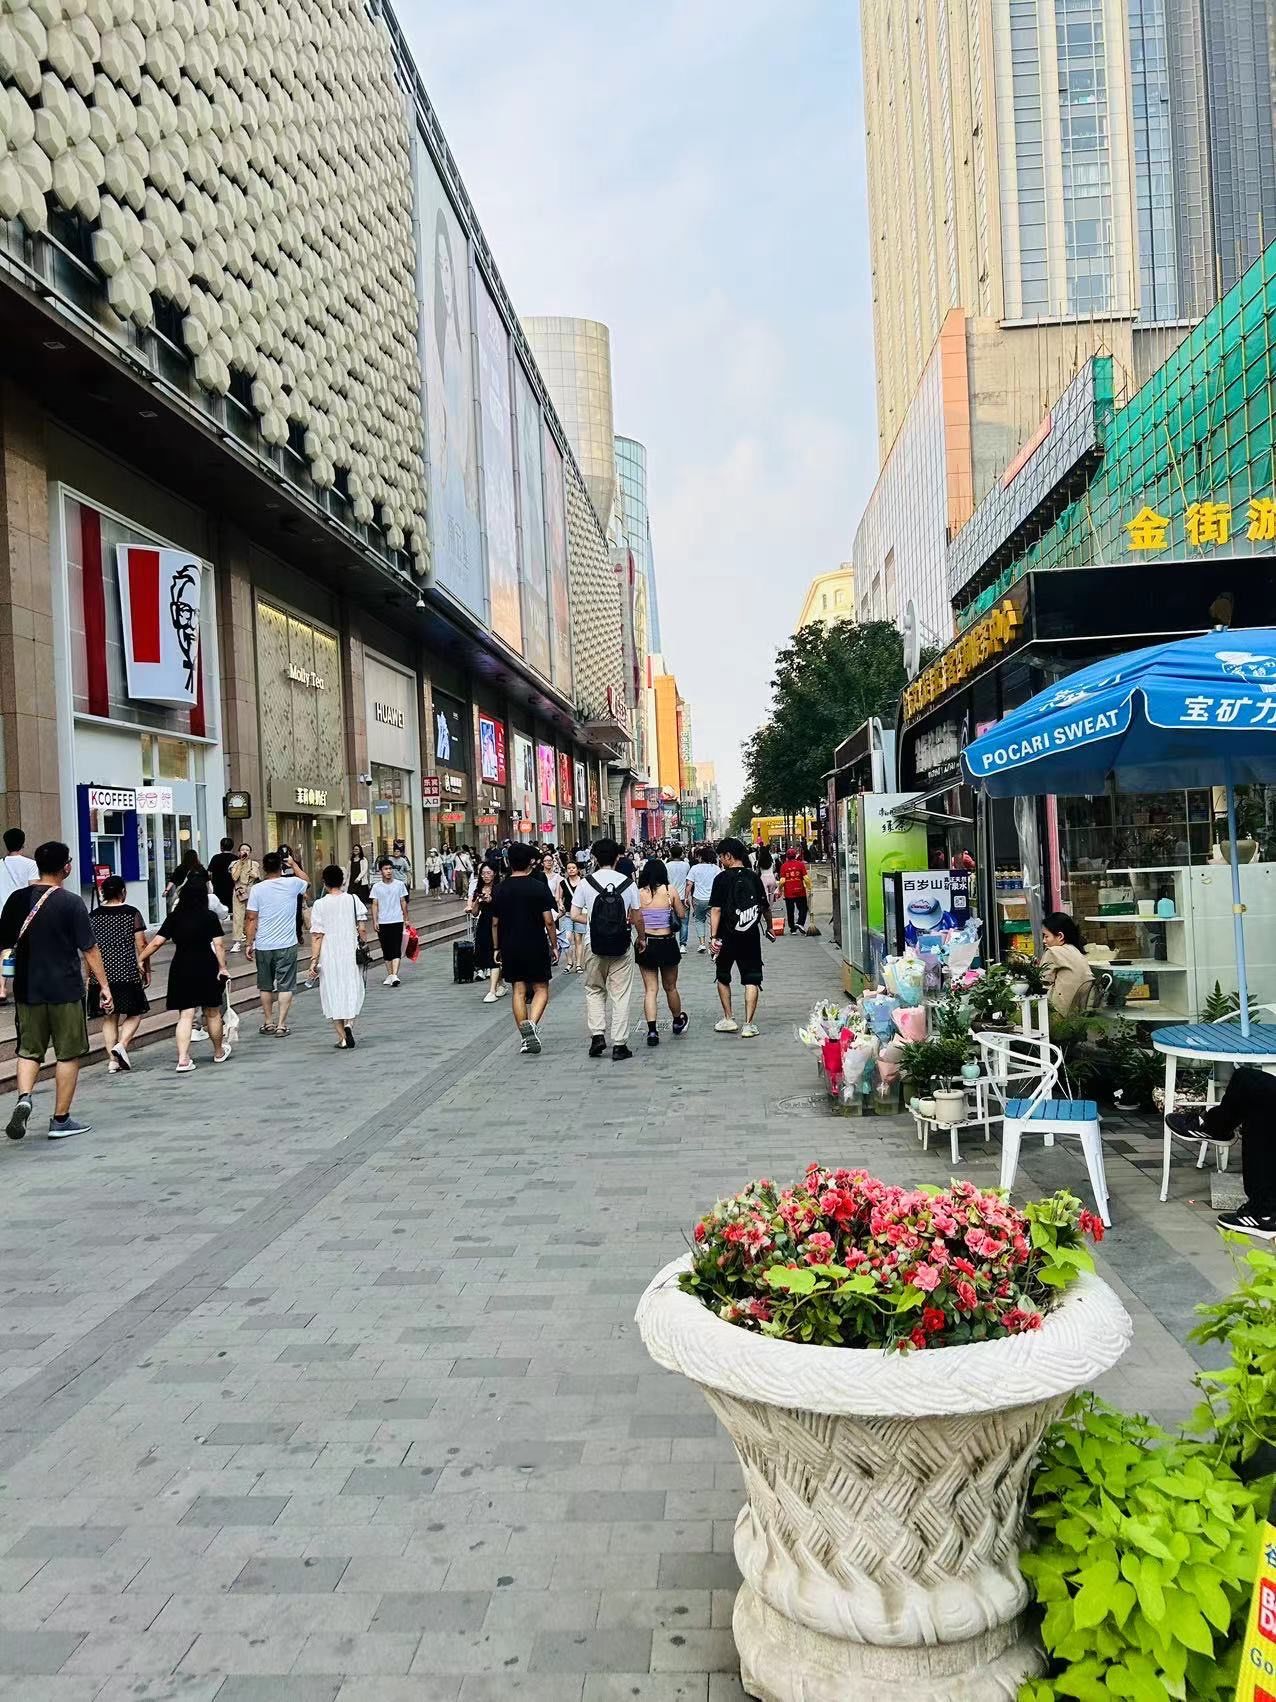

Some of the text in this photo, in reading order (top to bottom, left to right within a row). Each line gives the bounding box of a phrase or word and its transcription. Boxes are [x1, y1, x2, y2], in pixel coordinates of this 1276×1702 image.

[288, 662, 325, 690] Molly Tea
[375, 702, 405, 729] HUAWEI
[1180, 695, 1276, 724] 宝矿力
[982, 733, 1050, 770] POCARI
[1054, 709, 1119, 745] SWEAT
[91, 790, 134, 807] KCOFFEE
[424, 798, 439, 806] 入口
[903, 879, 943, 891] 百岁山
[740, 904, 759, 926] NIKE
